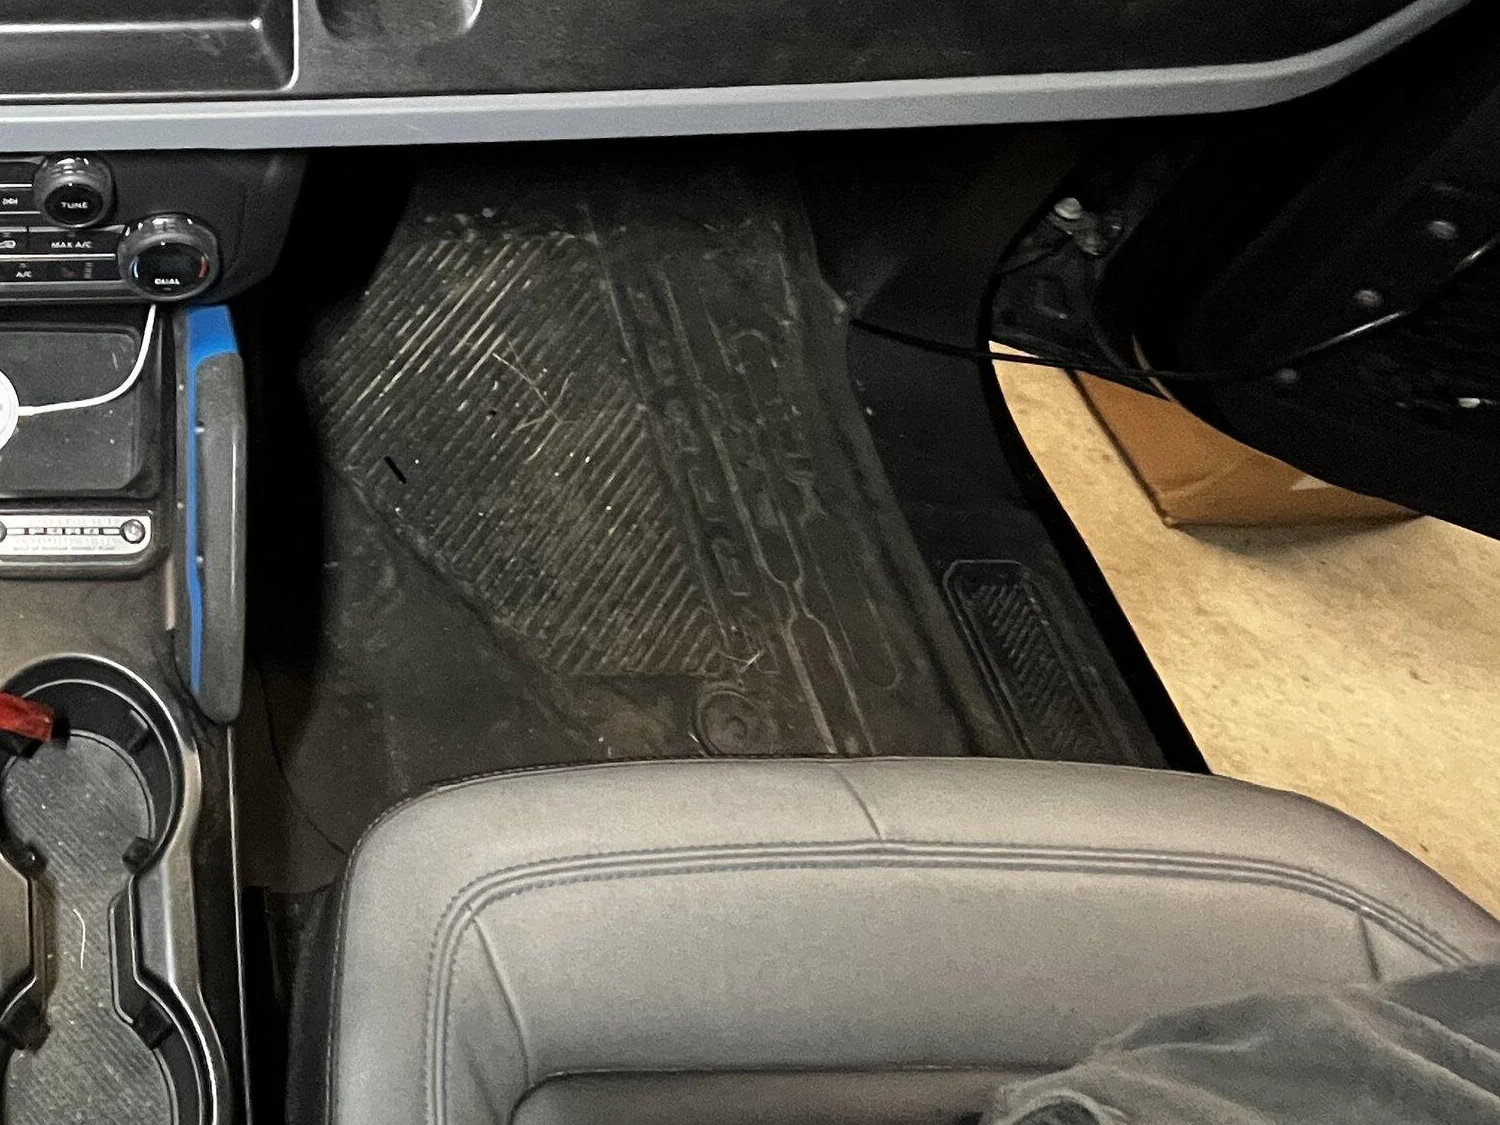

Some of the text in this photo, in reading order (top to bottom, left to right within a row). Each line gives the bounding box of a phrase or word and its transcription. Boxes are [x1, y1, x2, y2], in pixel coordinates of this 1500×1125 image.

[61, 201, 89, 209] TUNE
[51, 240, 92, 249] MAX A/C
[15, 270, 33, 278] A/C
[154, 277, 180, 285] DUAL
